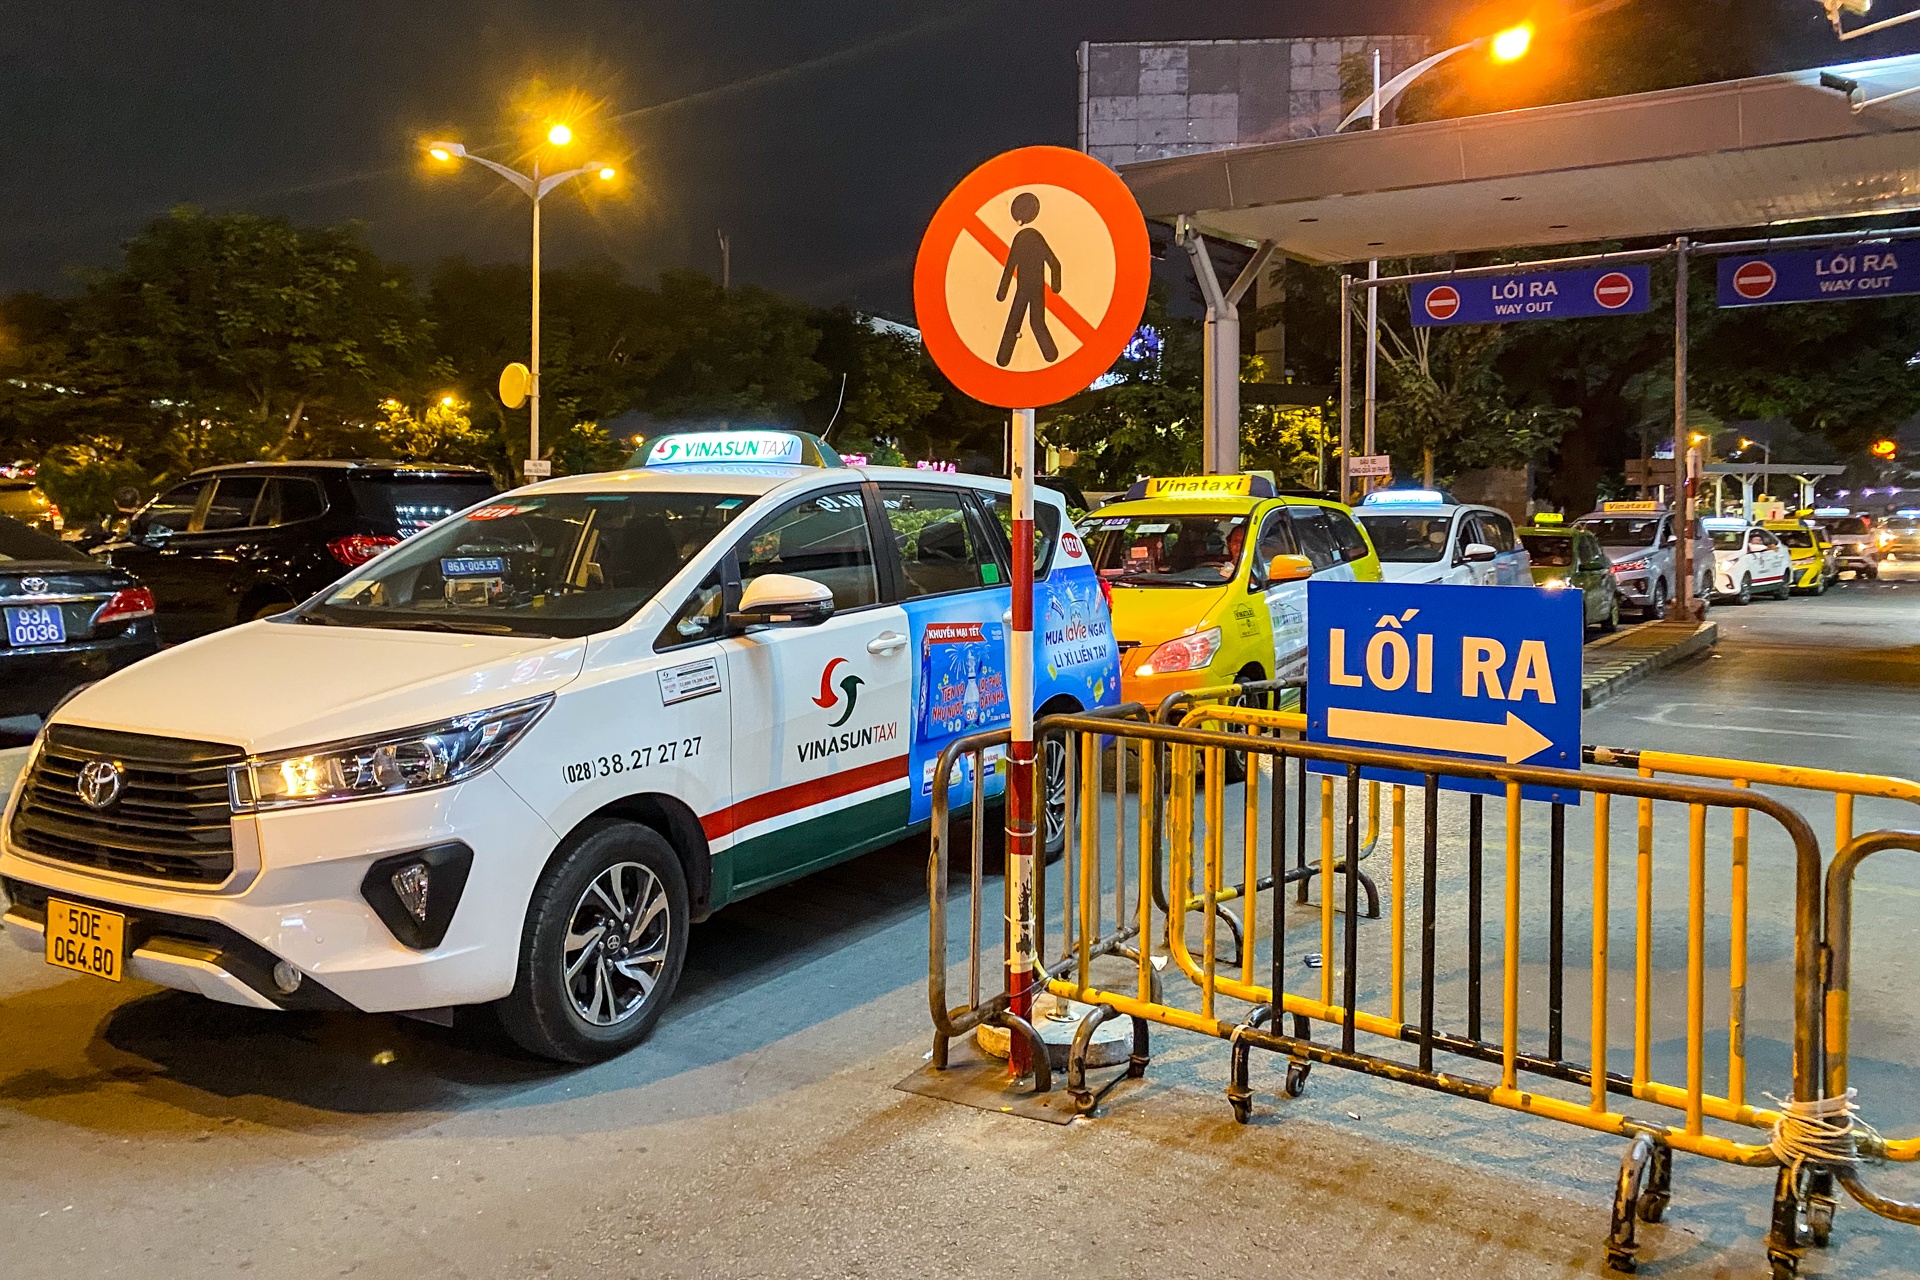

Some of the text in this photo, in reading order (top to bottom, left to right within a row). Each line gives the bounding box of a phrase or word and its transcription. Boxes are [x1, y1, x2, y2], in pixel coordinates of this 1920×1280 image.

[1863, 253, 1898, 272] RA
[1529, 281, 1558, 297] RA
[1820, 276, 1893, 292] WAY OUT
[1495, 301, 1553, 315] WAY OUT
[685, 440, 794, 457] VINASUN TAXI
[1155, 478, 1244, 493] Vinataxi
[18, 608, 51, 625] 93A
[15, 624, 59, 643] 0036
[1045, 629, 1064, 646] MUA
[1088, 622, 1107, 638] NGAY
[1093, 644, 1107, 660] TAY
[1329, 608, 1557, 704] LỐI RA
[657, 741, 678, 764] 27
[683, 736, 702, 758] 27
[68, 908, 101, 941] 50E
[54, 936, 114, 976] 064.80
